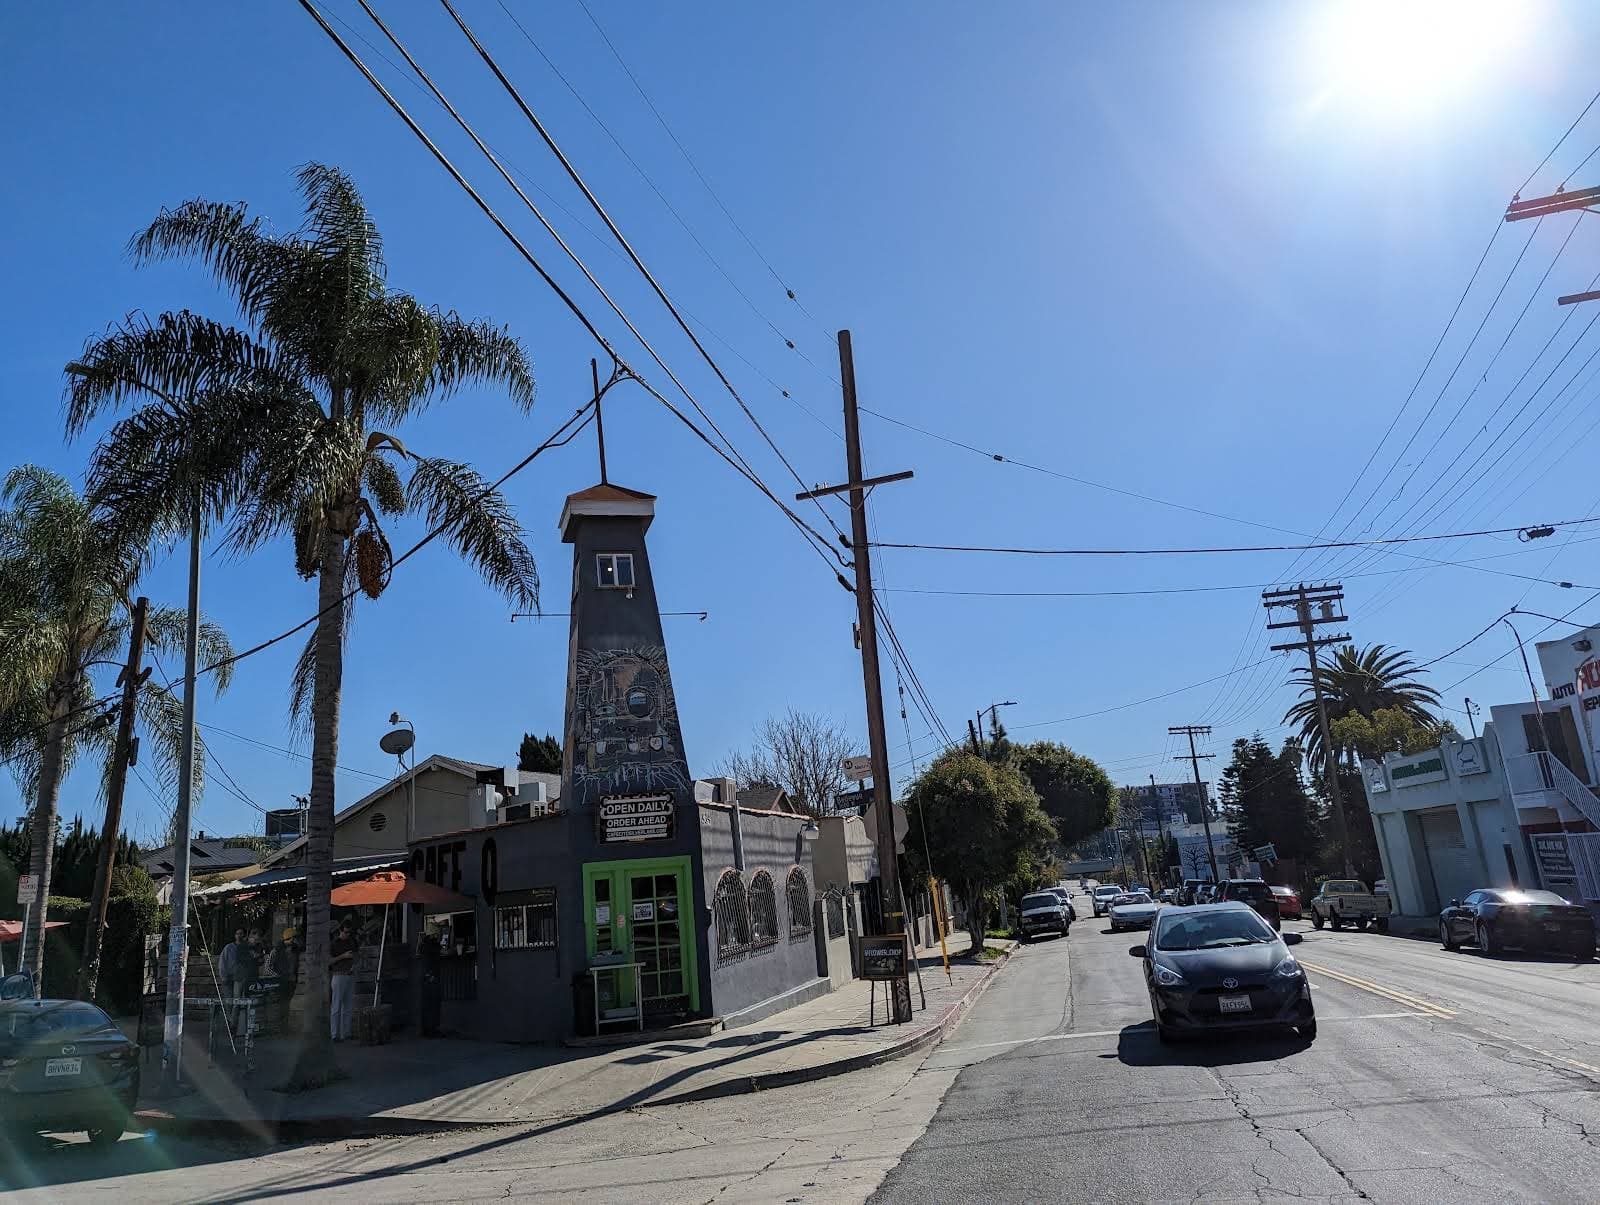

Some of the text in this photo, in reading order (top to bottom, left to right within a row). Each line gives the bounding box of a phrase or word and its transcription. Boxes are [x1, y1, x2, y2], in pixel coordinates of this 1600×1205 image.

[1552, 682, 1576, 700] AUTO
[606, 801, 667, 815] OPEN DAILY
[606, 815, 667, 828] ORDER AHEAD
